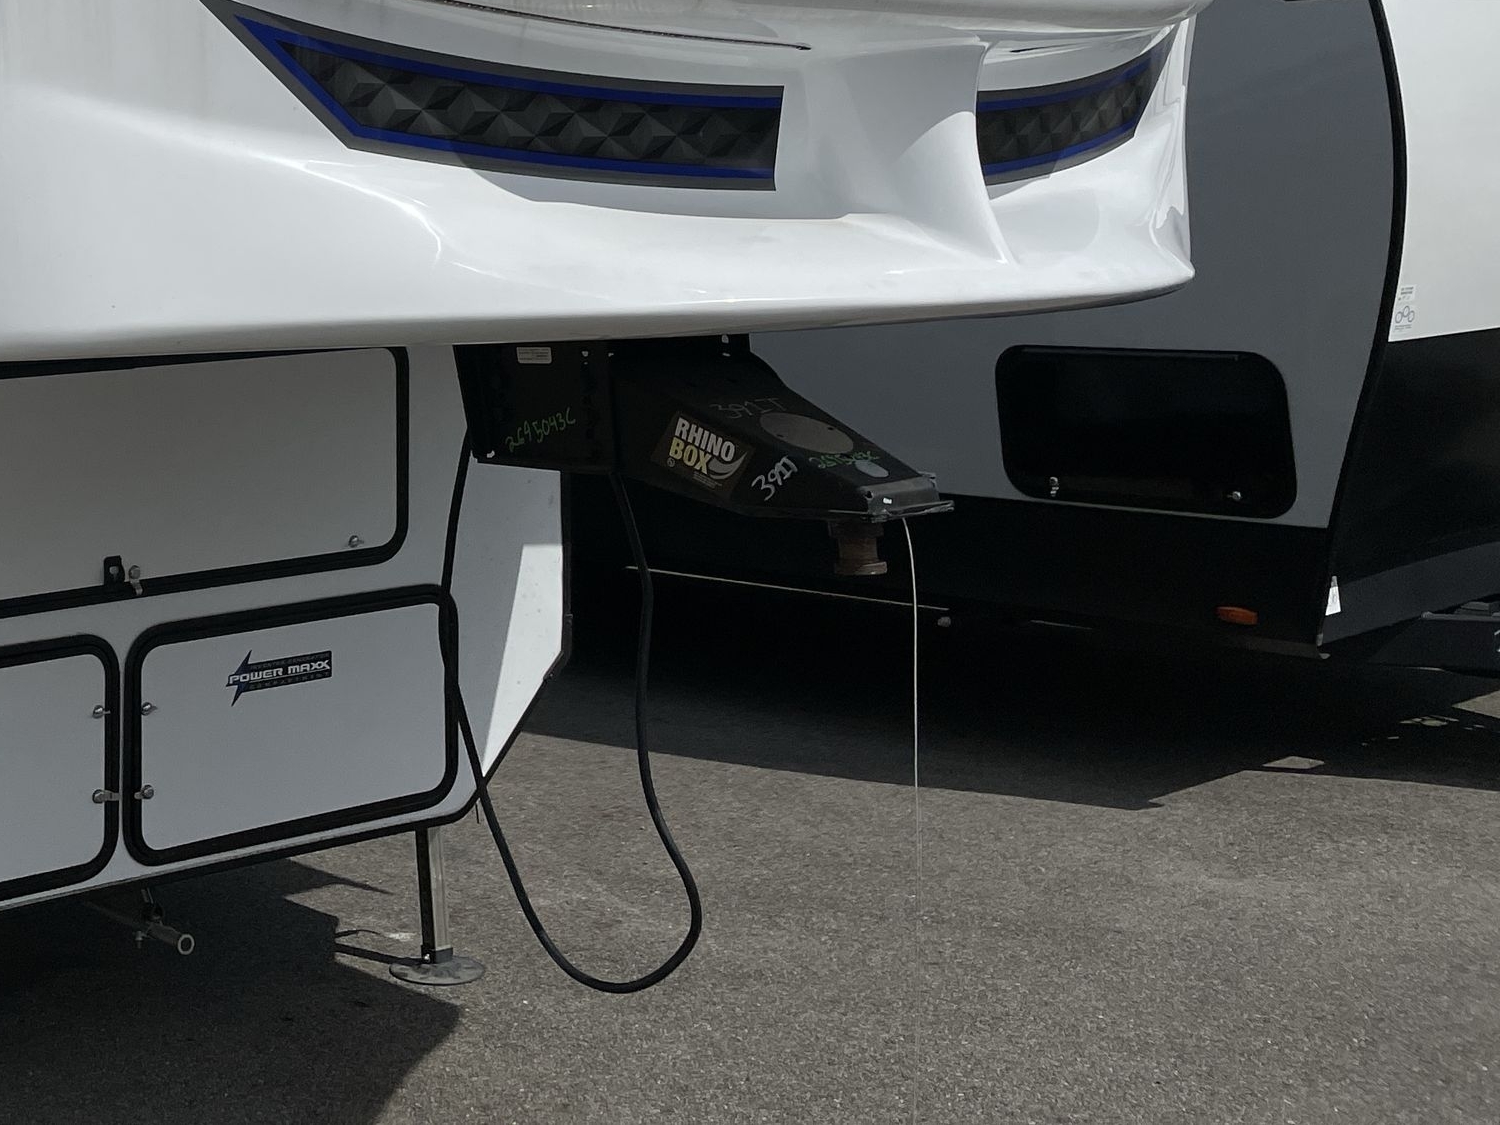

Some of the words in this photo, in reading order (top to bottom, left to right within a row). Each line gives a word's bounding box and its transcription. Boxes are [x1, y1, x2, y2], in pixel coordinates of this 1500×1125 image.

[668, 437, 712, 475] BOX
[674, 416, 736, 462] RHINO
[229, 668, 283, 684] POWER
[288, 660, 330, 674] MAXX
